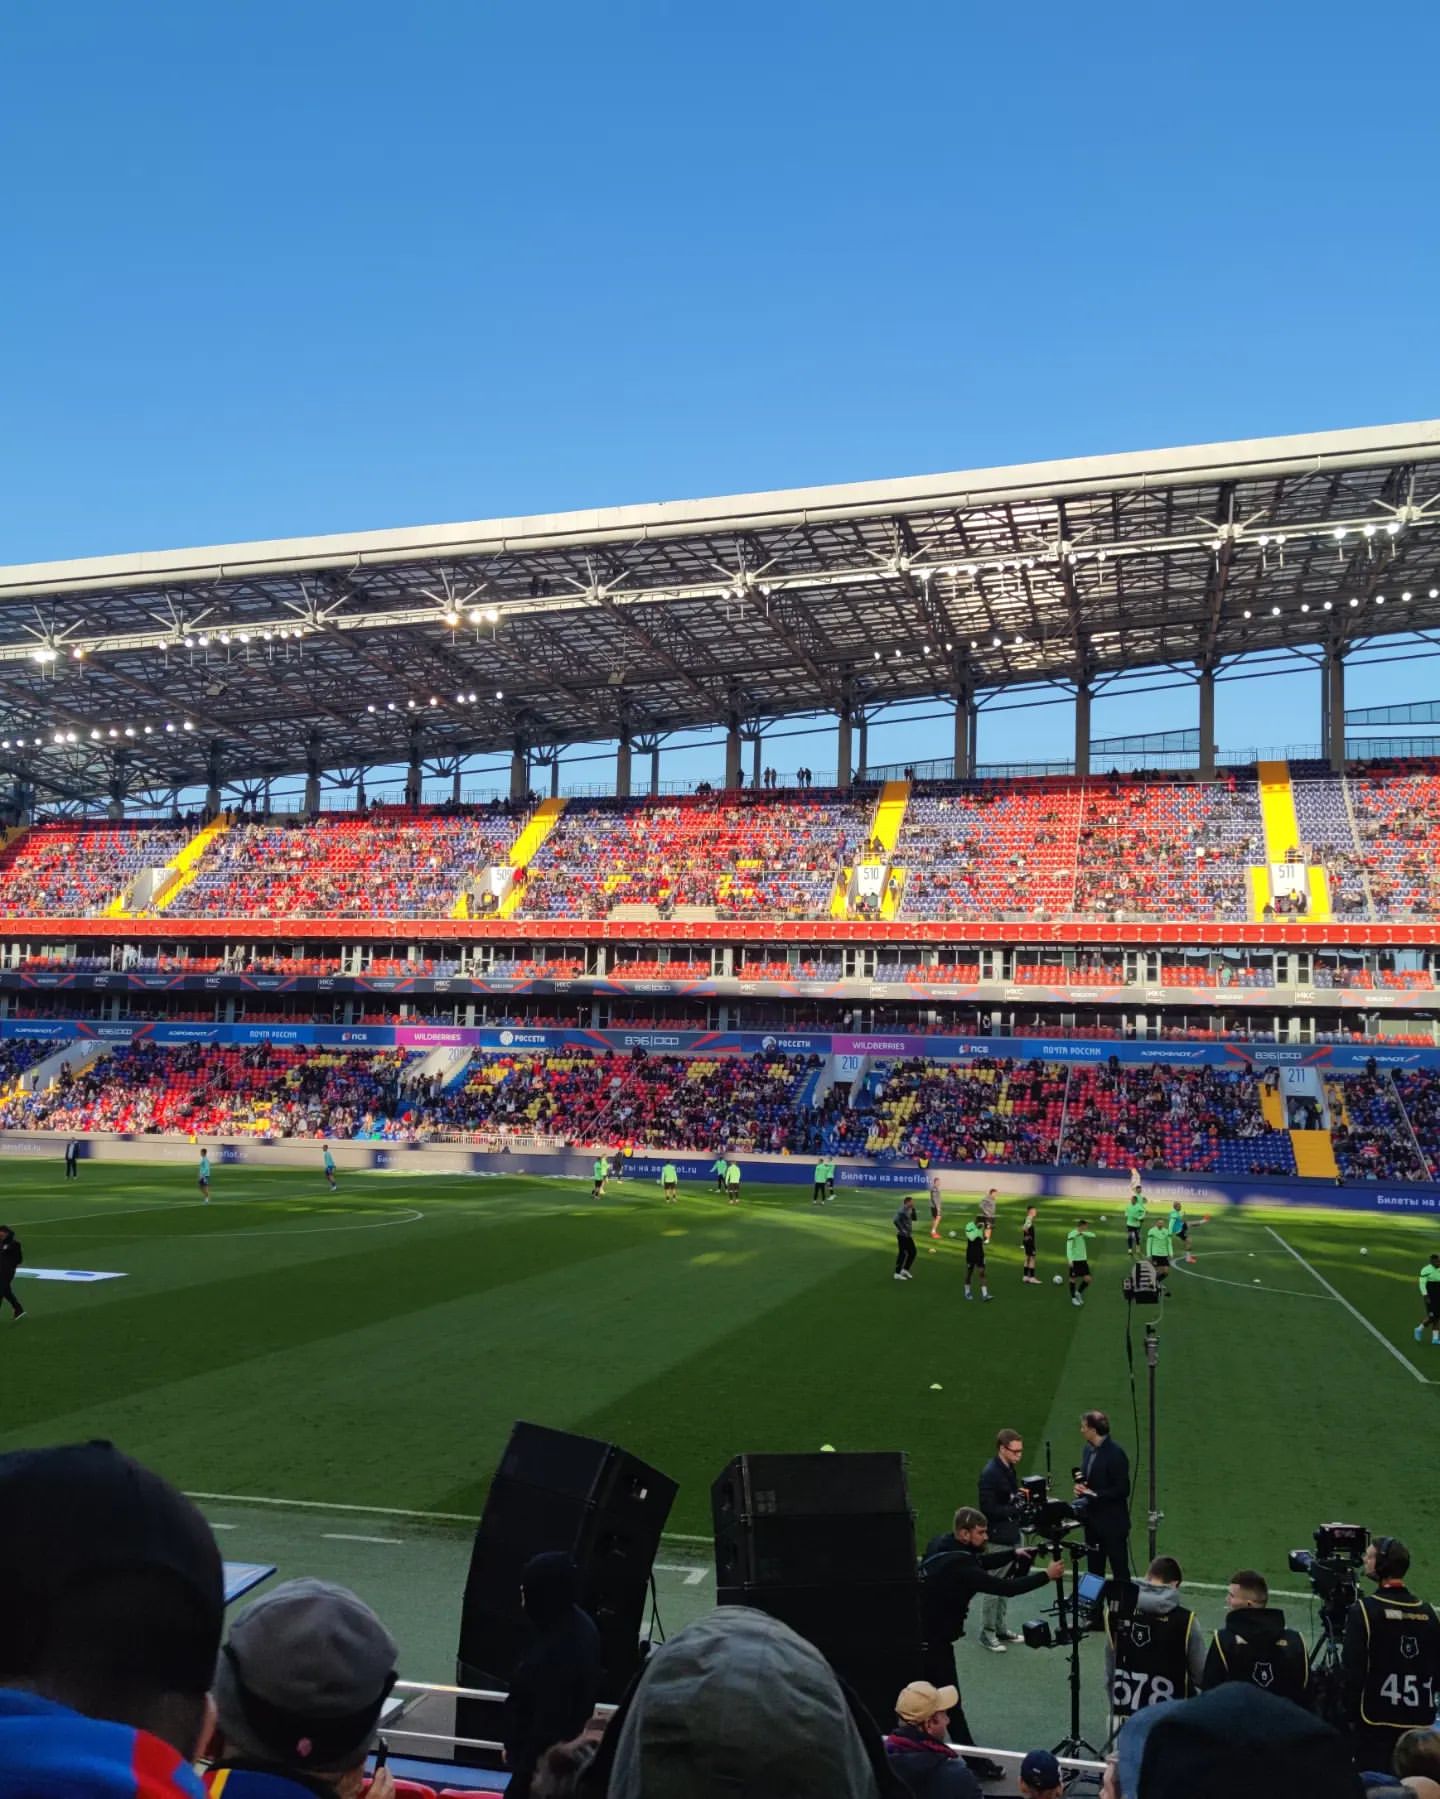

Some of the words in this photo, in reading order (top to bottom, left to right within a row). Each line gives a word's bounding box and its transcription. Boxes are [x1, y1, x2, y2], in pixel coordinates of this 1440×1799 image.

[863, 867, 879, 880] 510
[1278, 865, 1295, 879] 511
[414, 1033, 461, 1041] WILDBERRIES
[514, 1035, 546, 1043] РОССЕТИ
[778, 1040, 811, 1048] РОССЕТИ
[852, 1041, 905, 1050] WILDBERRIES
[1043, 1045, 1068, 1055] ПОЧТА
[1070, 1047, 1102, 1056] РОССИИ
[841, 1055, 858, 1070] 210
[1288, 1067, 1305, 1083] 211
[841, 1171, 877, 1182] Билеты
[880, 1174, 891, 1182] на
[894, 1174, 932, 1184] aeroflot.
[1377, 1194, 1419, 1206] Билеты
[1422, 1198, 1435, 1206] на
[1112, 1668, 1175, 1711] 678
[1380, 1673, 1434, 1708] 451
